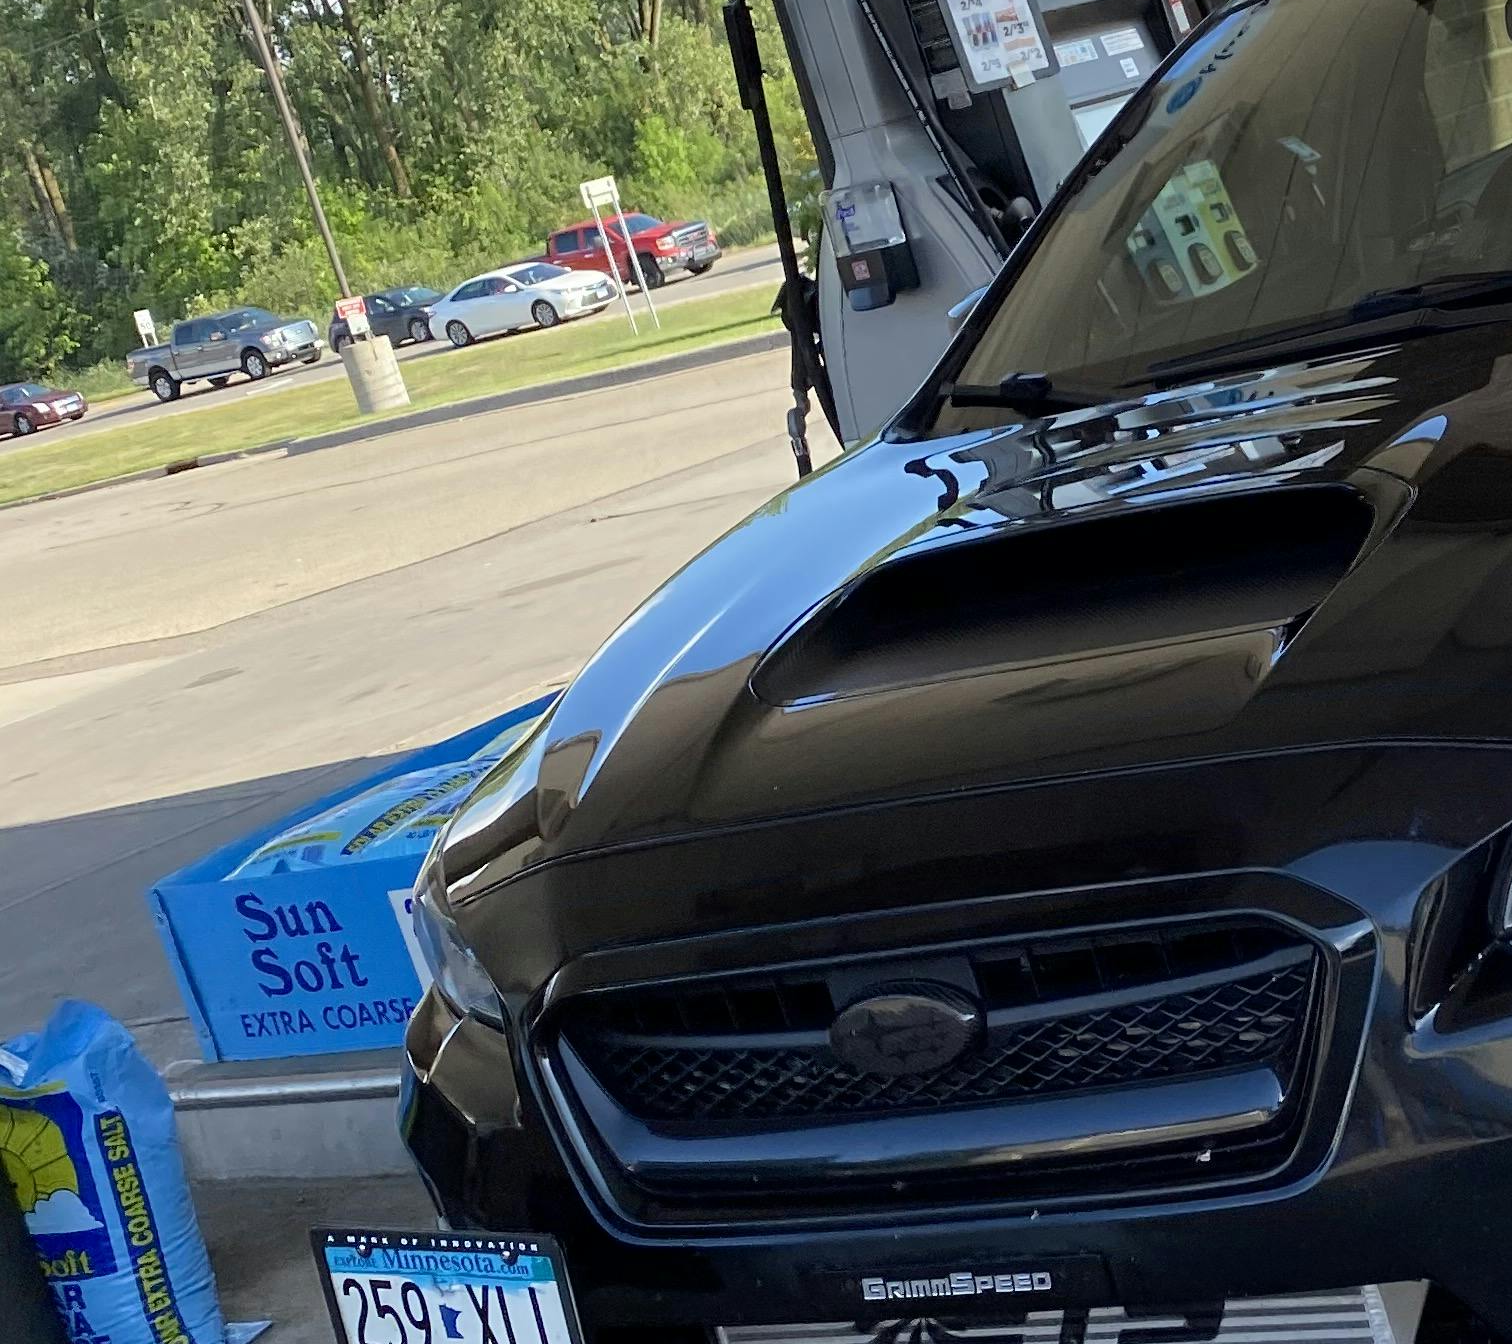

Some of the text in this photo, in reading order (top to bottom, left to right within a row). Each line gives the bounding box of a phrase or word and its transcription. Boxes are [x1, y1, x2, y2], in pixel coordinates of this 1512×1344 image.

[235, 891, 343, 943] Sun
[251, 942, 368, 998] Soft
[240, 997, 414, 1038] EXTRA COARSE
[100, 1115, 130, 1162] SALT
[113, 1163, 154, 1246] COARSE
[327, 1234, 538, 1252] A MARK OF INNOVATION
[137, 1248, 171, 1313] EXTRA
